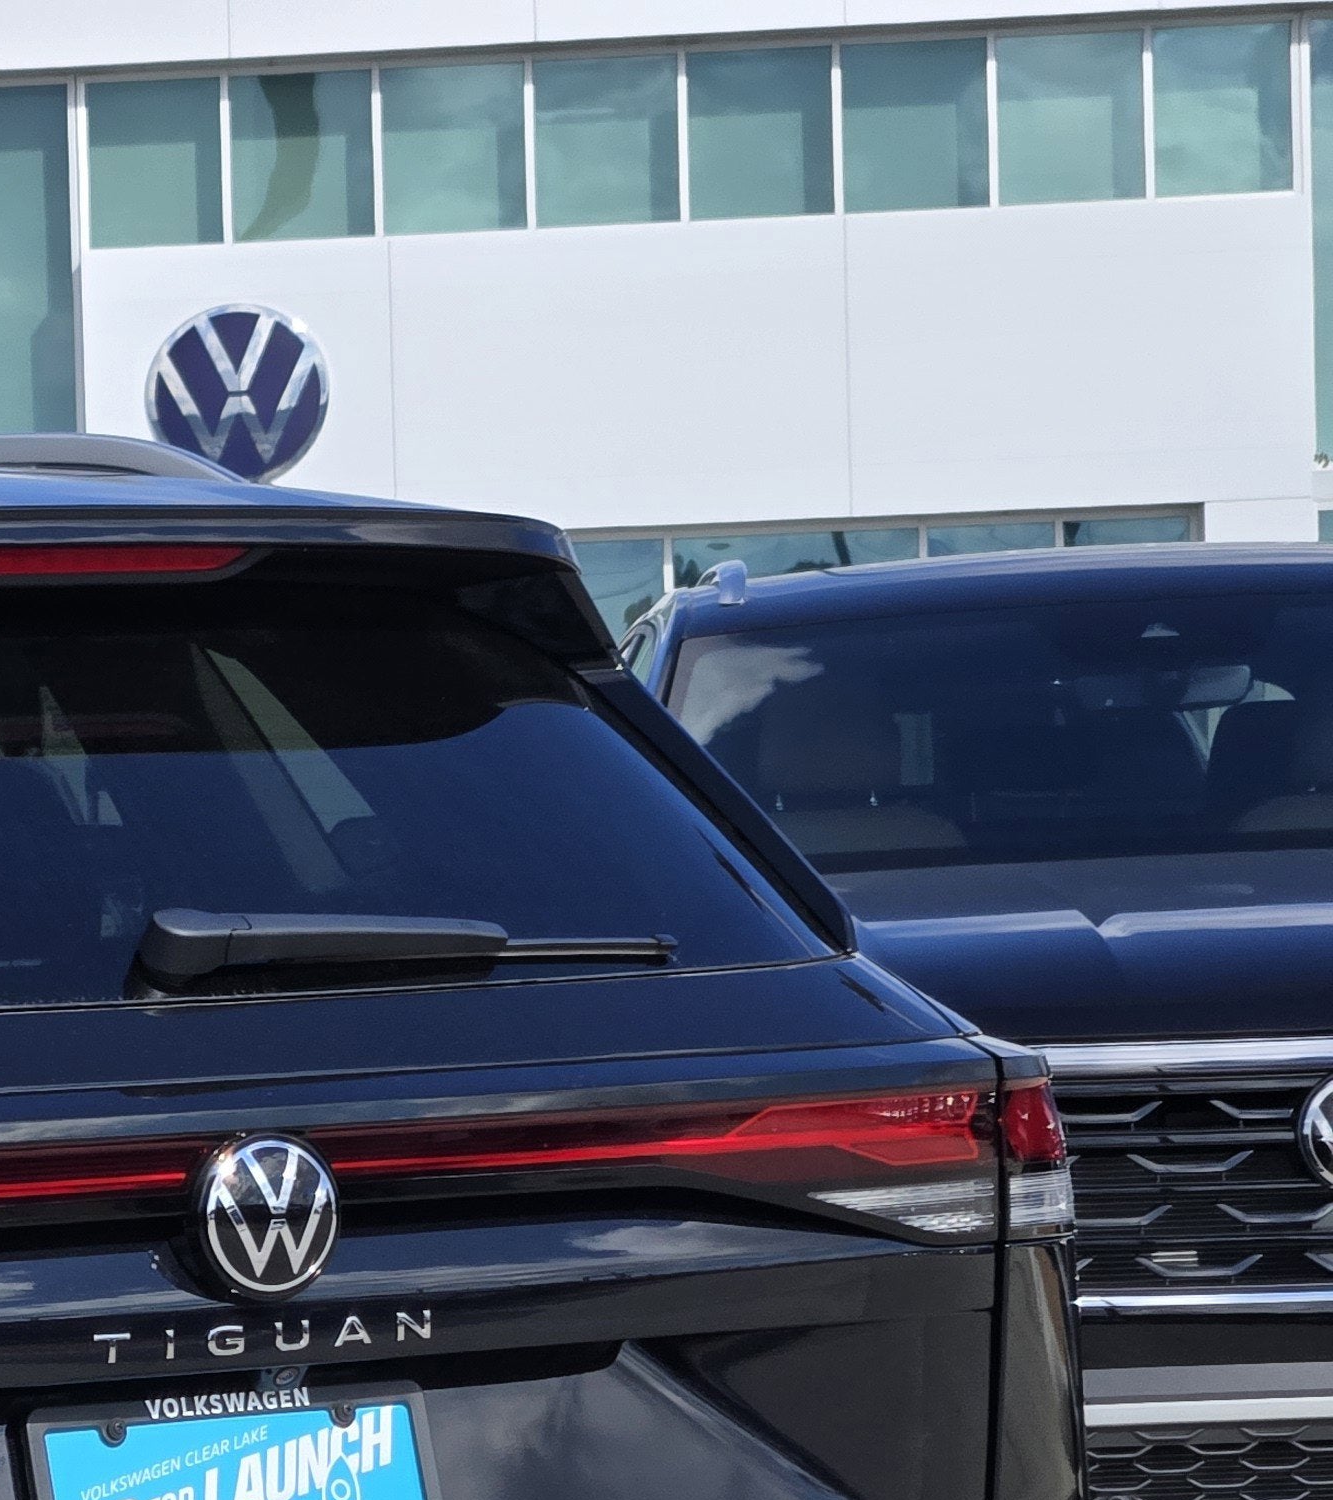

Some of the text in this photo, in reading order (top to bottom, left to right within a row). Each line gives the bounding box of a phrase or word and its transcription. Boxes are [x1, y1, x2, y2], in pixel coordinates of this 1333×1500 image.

[148, 306, 327, 470] VW
[211, 1142, 335, 1286] VW
[93, 1309, 432, 1364] TIGUAN
[145, 1387, 311, 1419] VOLKSWAGEN
[184, 1438, 230, 1468] CLEAR
[233, 1425, 269, 1450] LAKE
